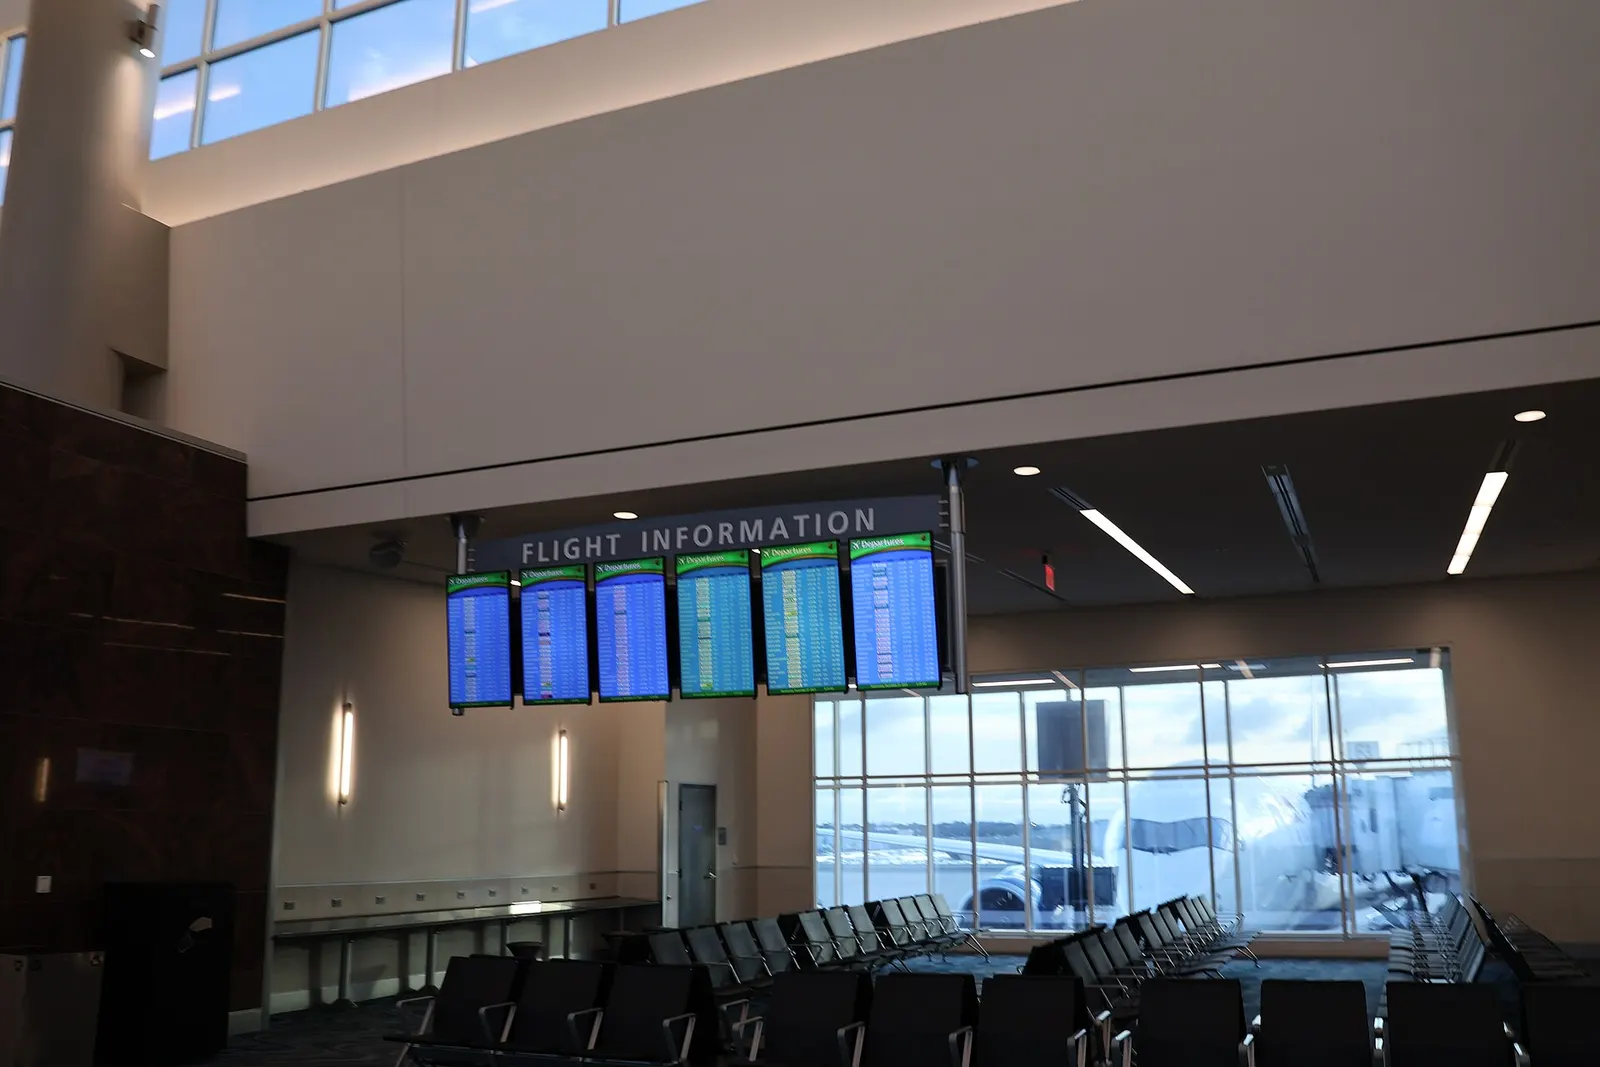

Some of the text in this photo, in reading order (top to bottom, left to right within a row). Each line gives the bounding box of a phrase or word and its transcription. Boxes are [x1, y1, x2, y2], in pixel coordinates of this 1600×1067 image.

[522, 508, 875, 565] FLIGHT INFORMATION
[861, 538, 904, 549] Departures
